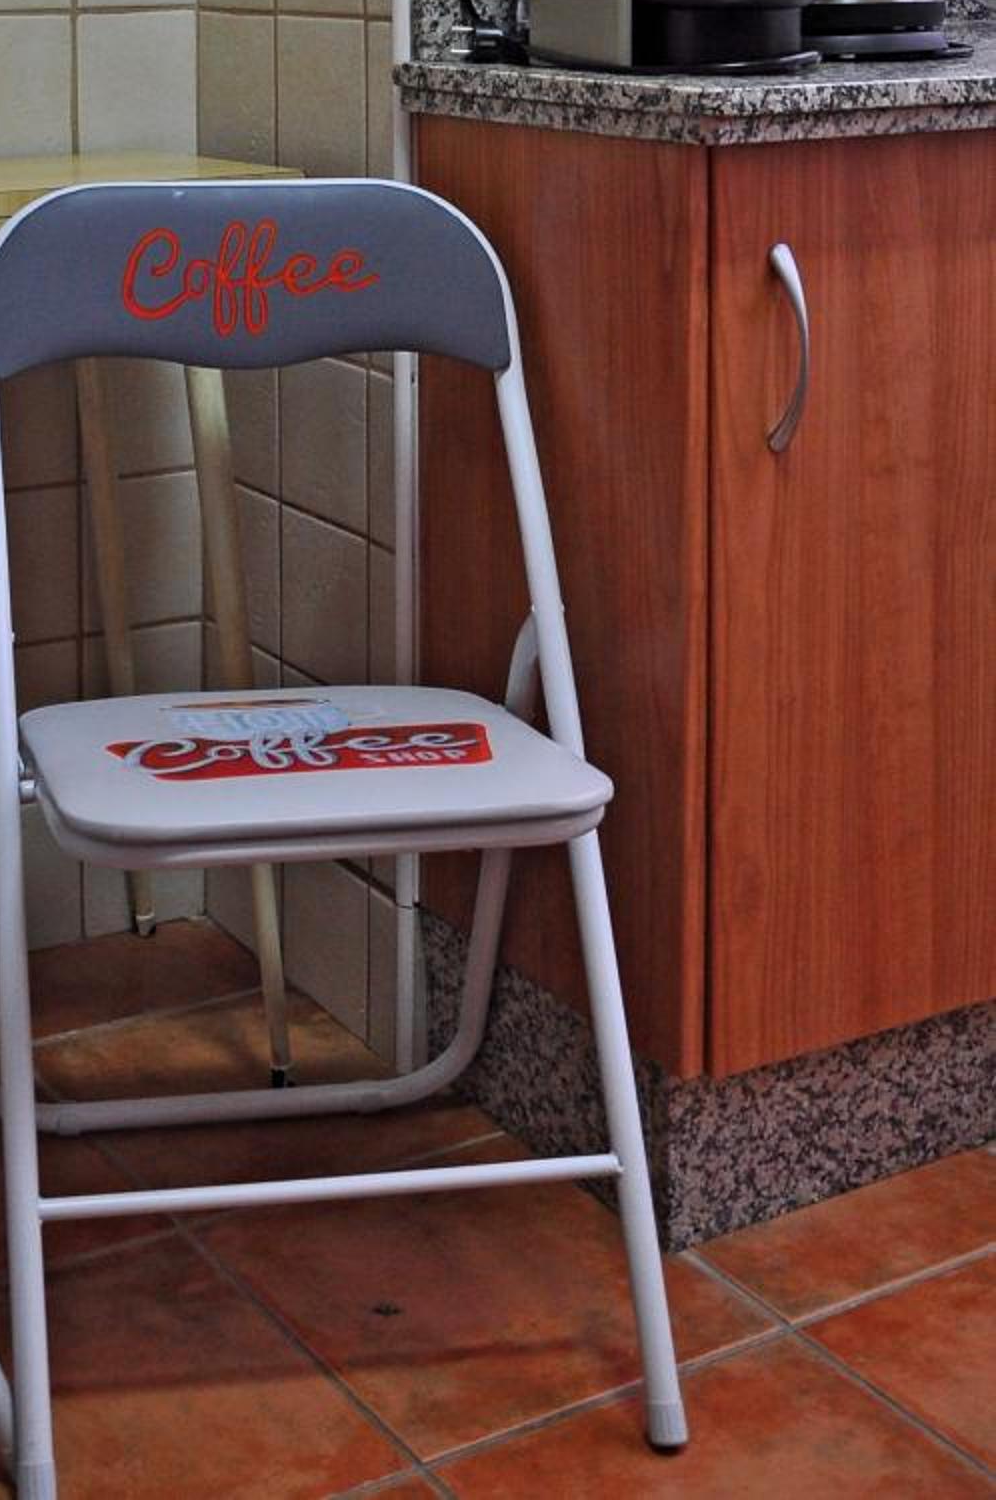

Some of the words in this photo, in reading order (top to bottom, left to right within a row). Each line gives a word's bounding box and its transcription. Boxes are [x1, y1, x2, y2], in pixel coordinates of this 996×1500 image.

[121, 219, 380, 337] Coffee
[123, 728, 478, 775] Coffee
[359, 749, 468, 763] SHOP
